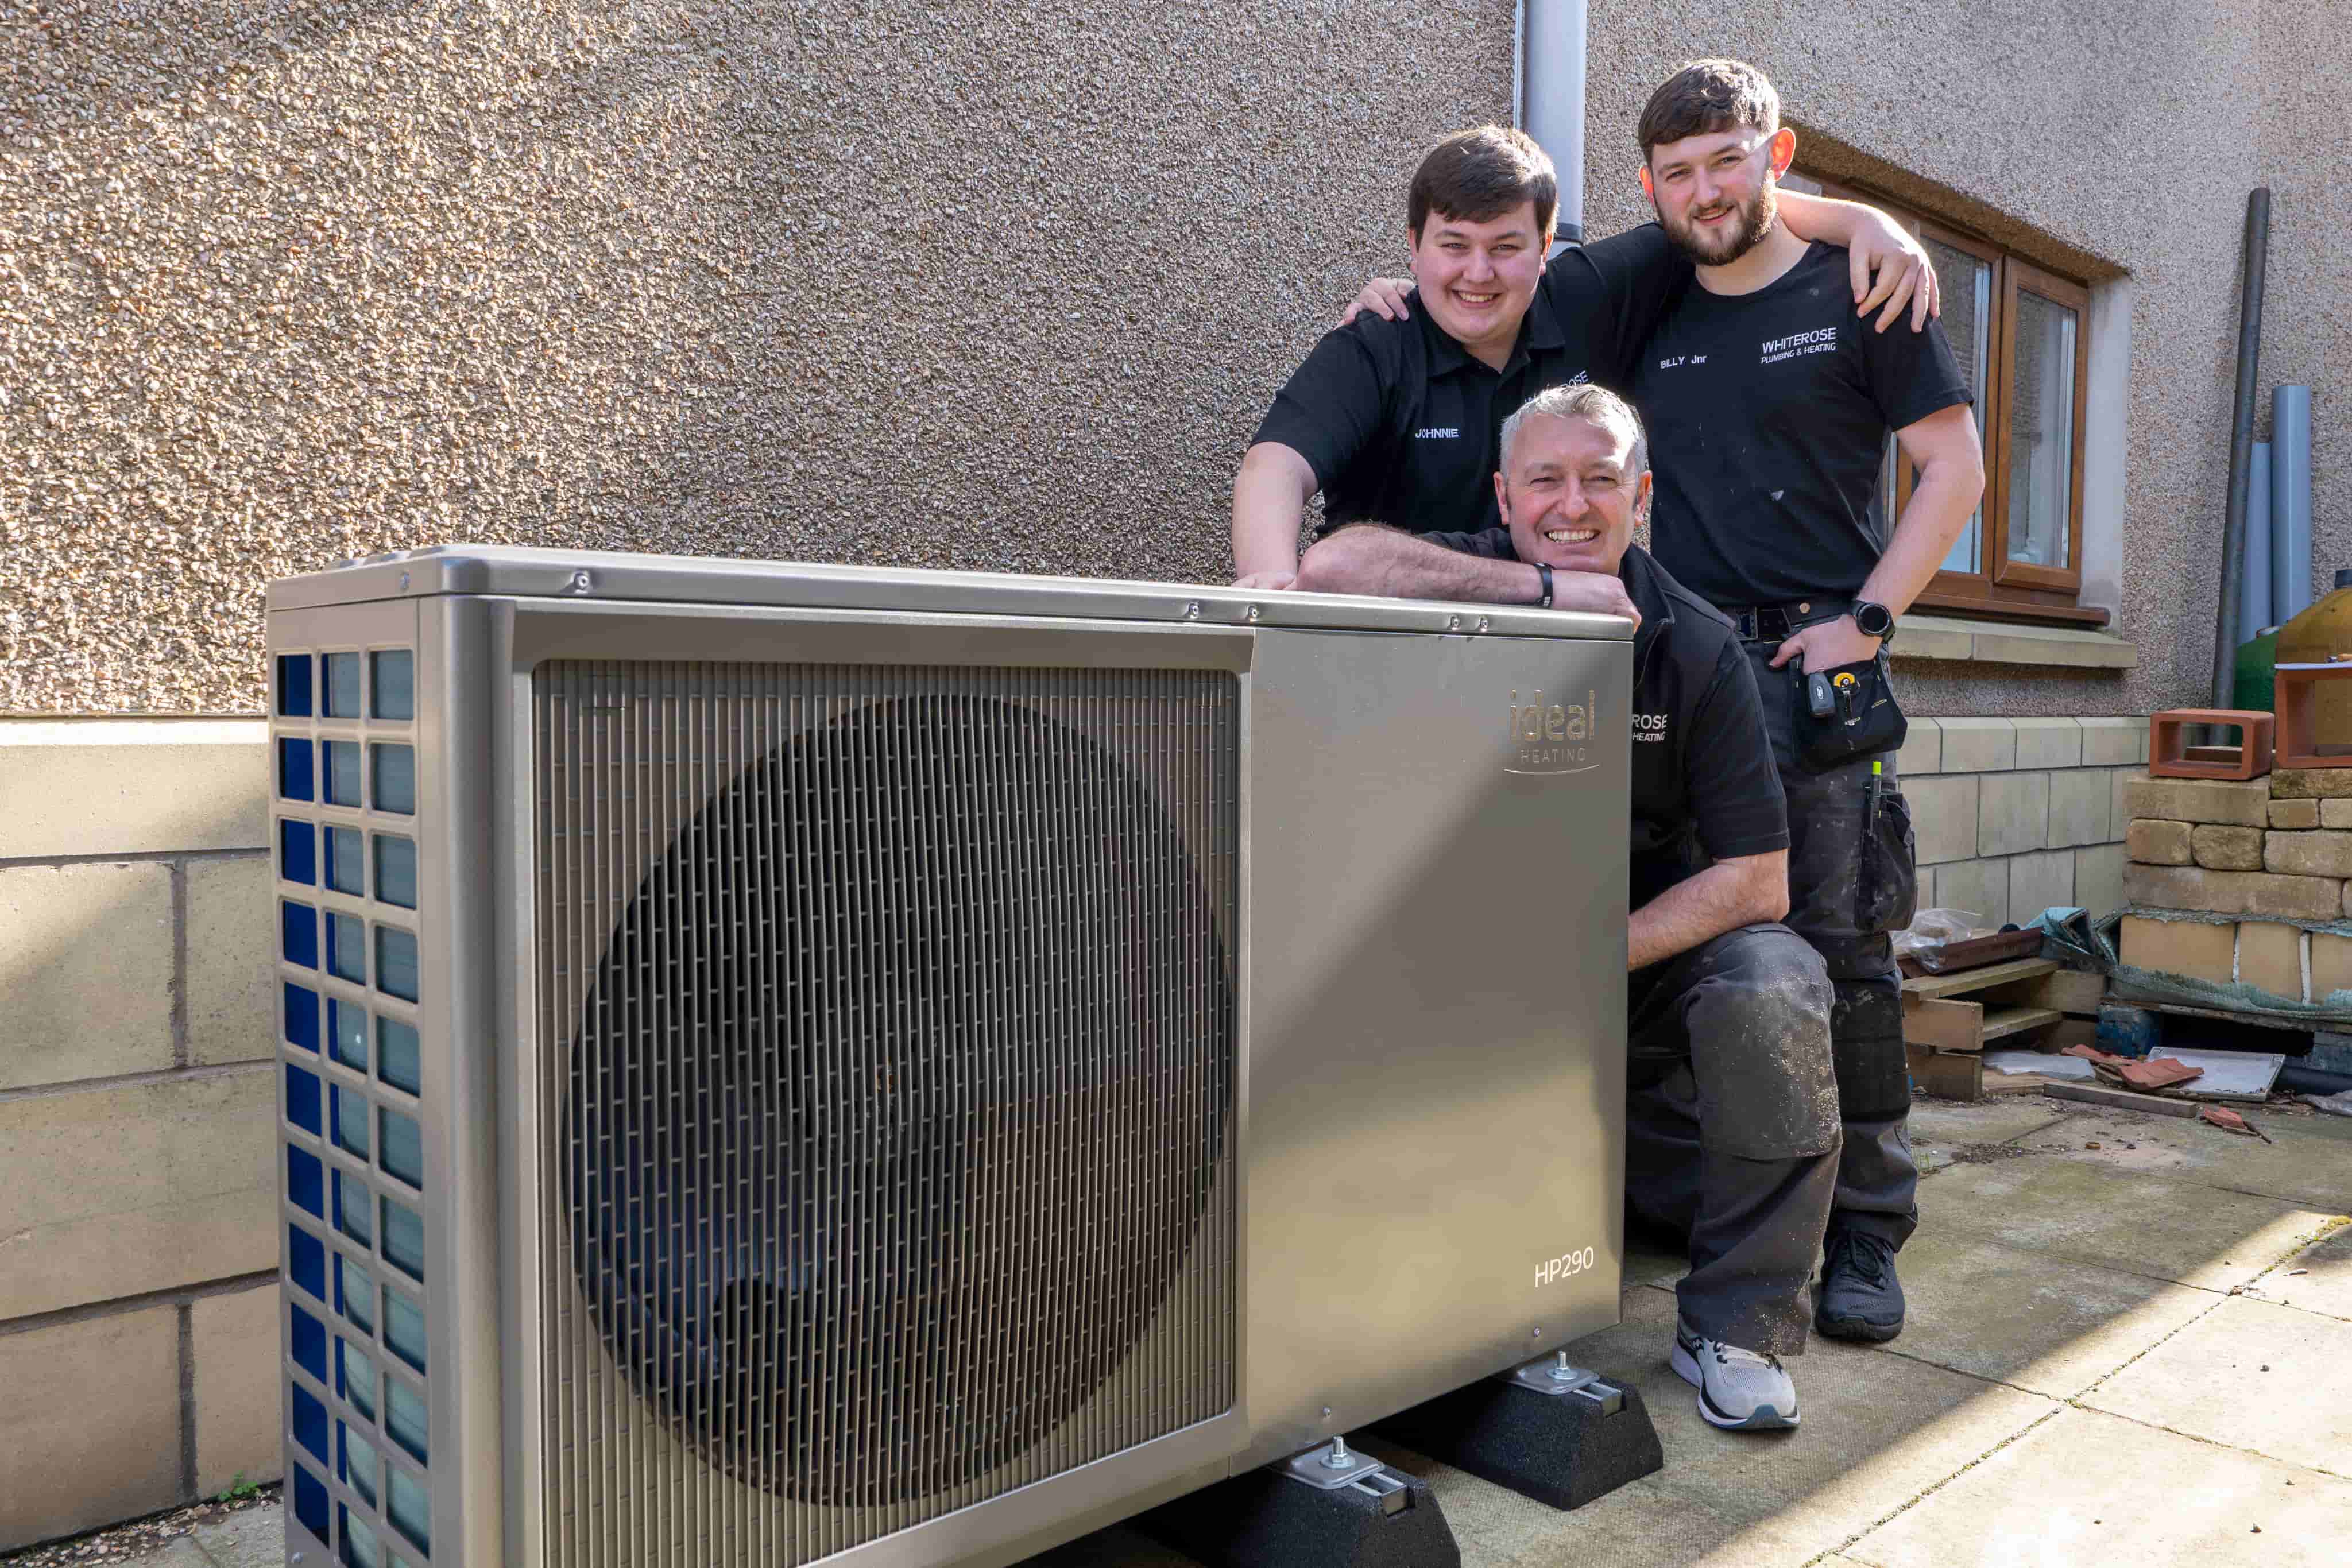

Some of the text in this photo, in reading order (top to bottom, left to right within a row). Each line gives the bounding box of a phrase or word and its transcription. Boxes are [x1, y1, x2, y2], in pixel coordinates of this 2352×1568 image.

[1762, 327, 1837, 354] WHITEROSE
[1660, 354, 1708, 369] BILLY Jnr
[1760, 342, 1836, 364] PLUMBING & HEATING
[1414, 428, 1459, 438] JOHNNIE
[1510, 688, 1595, 742] ideal
[1521, 748, 1586, 764] HEATING
[1534, 1245, 1594, 1288] HP290
